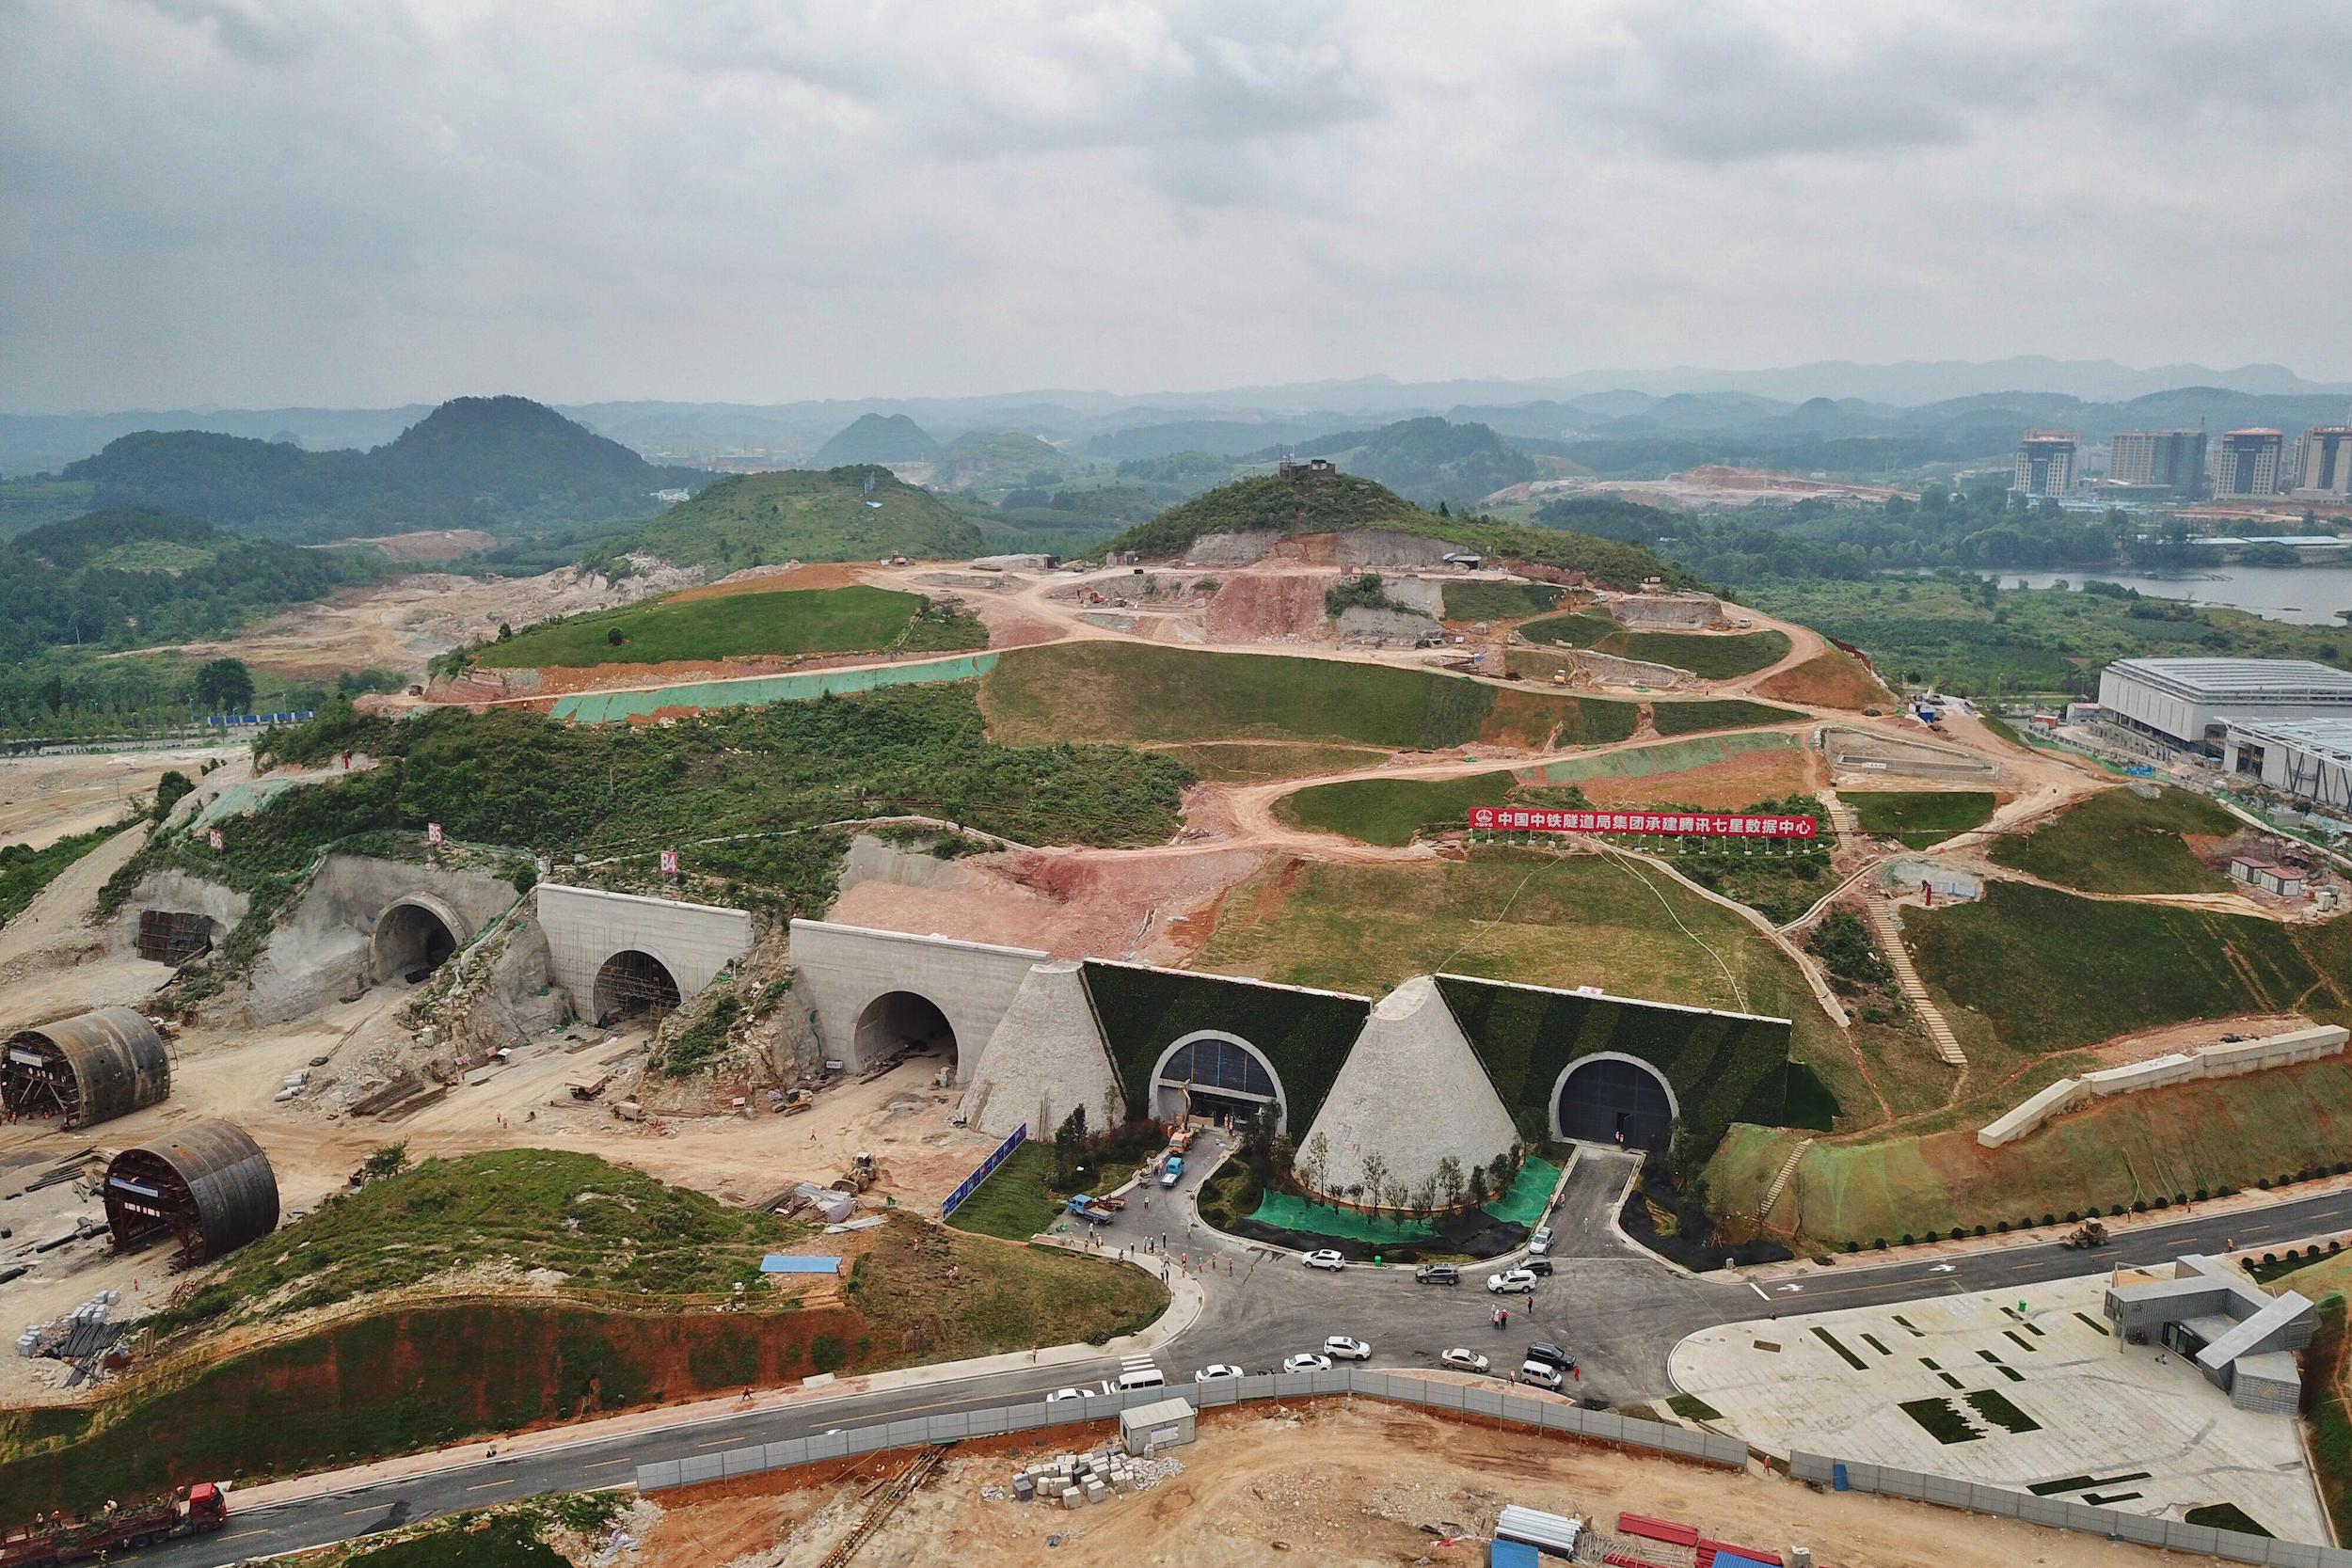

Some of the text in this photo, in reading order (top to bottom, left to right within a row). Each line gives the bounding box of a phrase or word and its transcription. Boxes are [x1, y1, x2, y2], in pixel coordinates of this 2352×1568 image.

[428, 824, 441, 843] B5
[1498, 812, 1811, 835] 中国中铁隧道局集团承建腾讯七星数据中心
[210, 831, 222, 848] B6
[660, 852, 676, 873] B4
